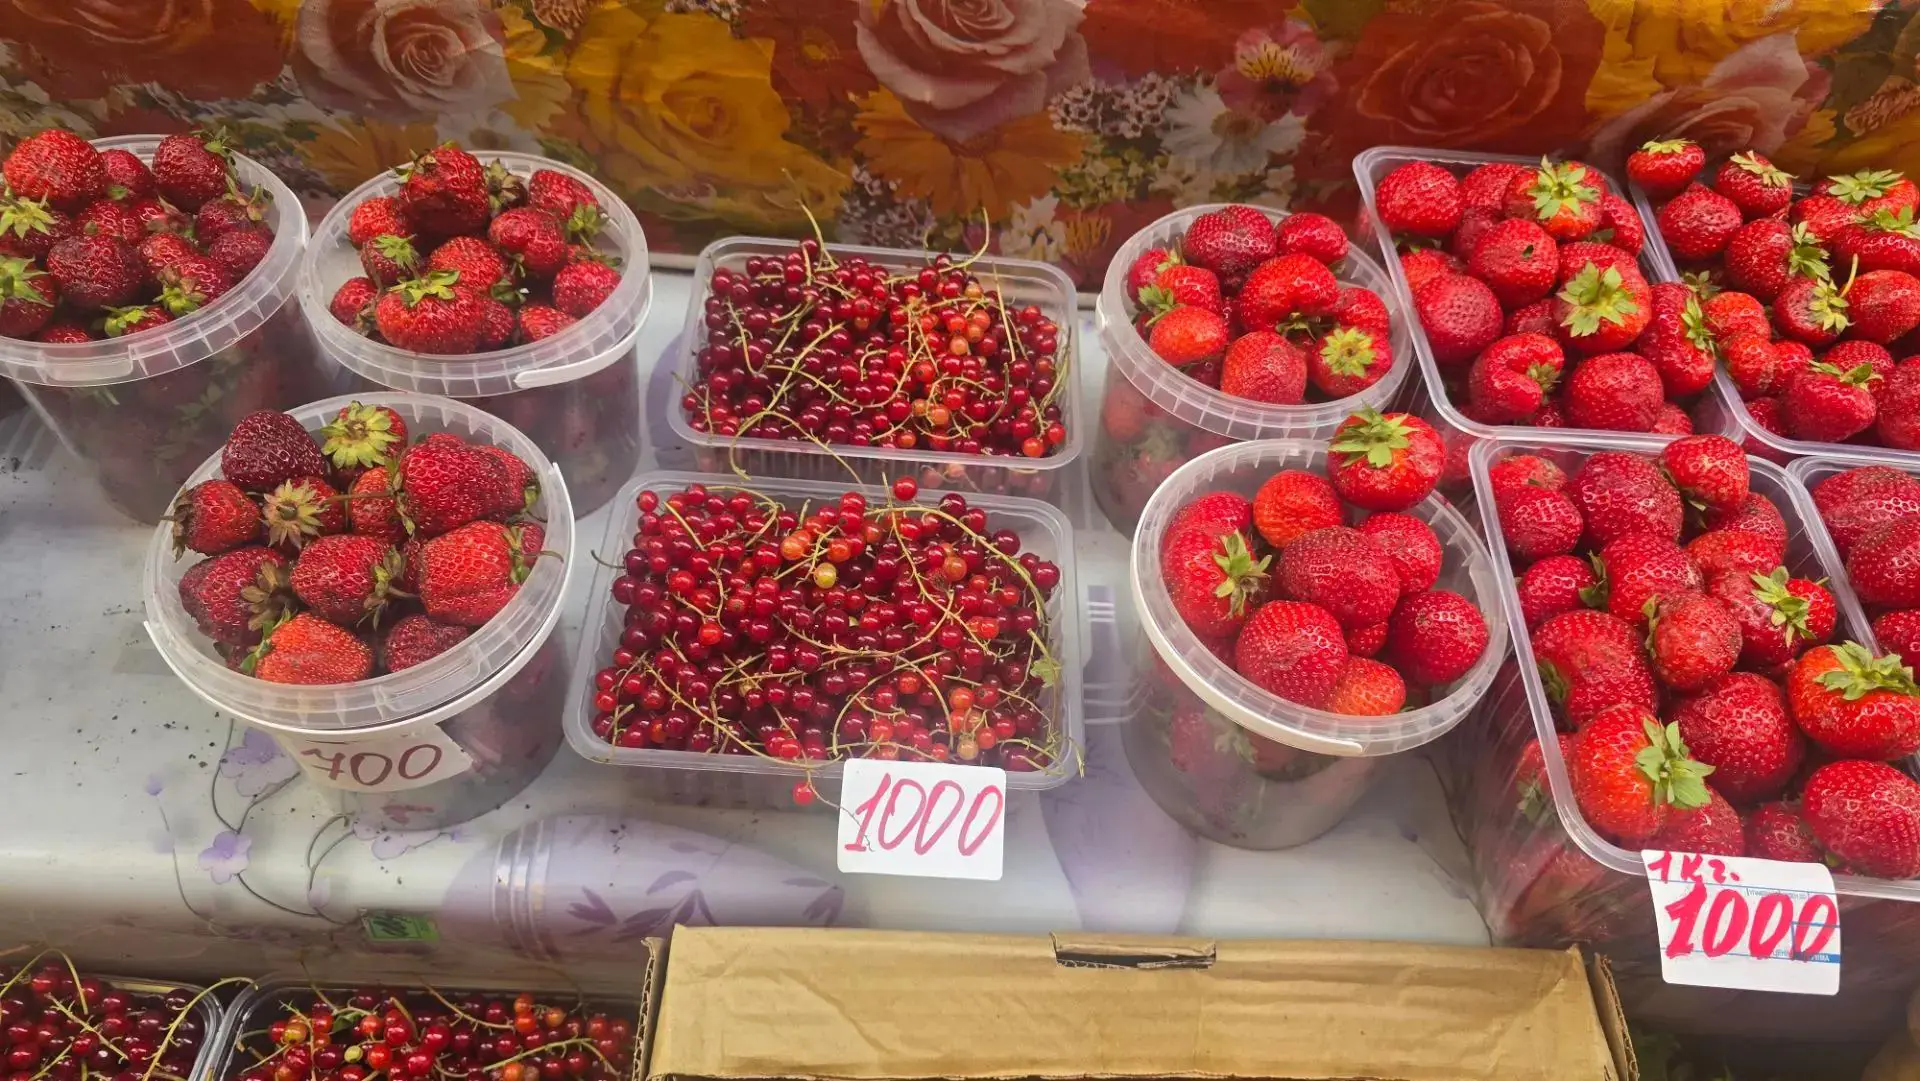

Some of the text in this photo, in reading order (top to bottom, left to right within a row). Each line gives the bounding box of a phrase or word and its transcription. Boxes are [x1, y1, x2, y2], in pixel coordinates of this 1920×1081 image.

[301, 744, 442, 785] 700
[844, 773, 1003, 856] 1000
[1665, 880, 1838, 962] 1000
